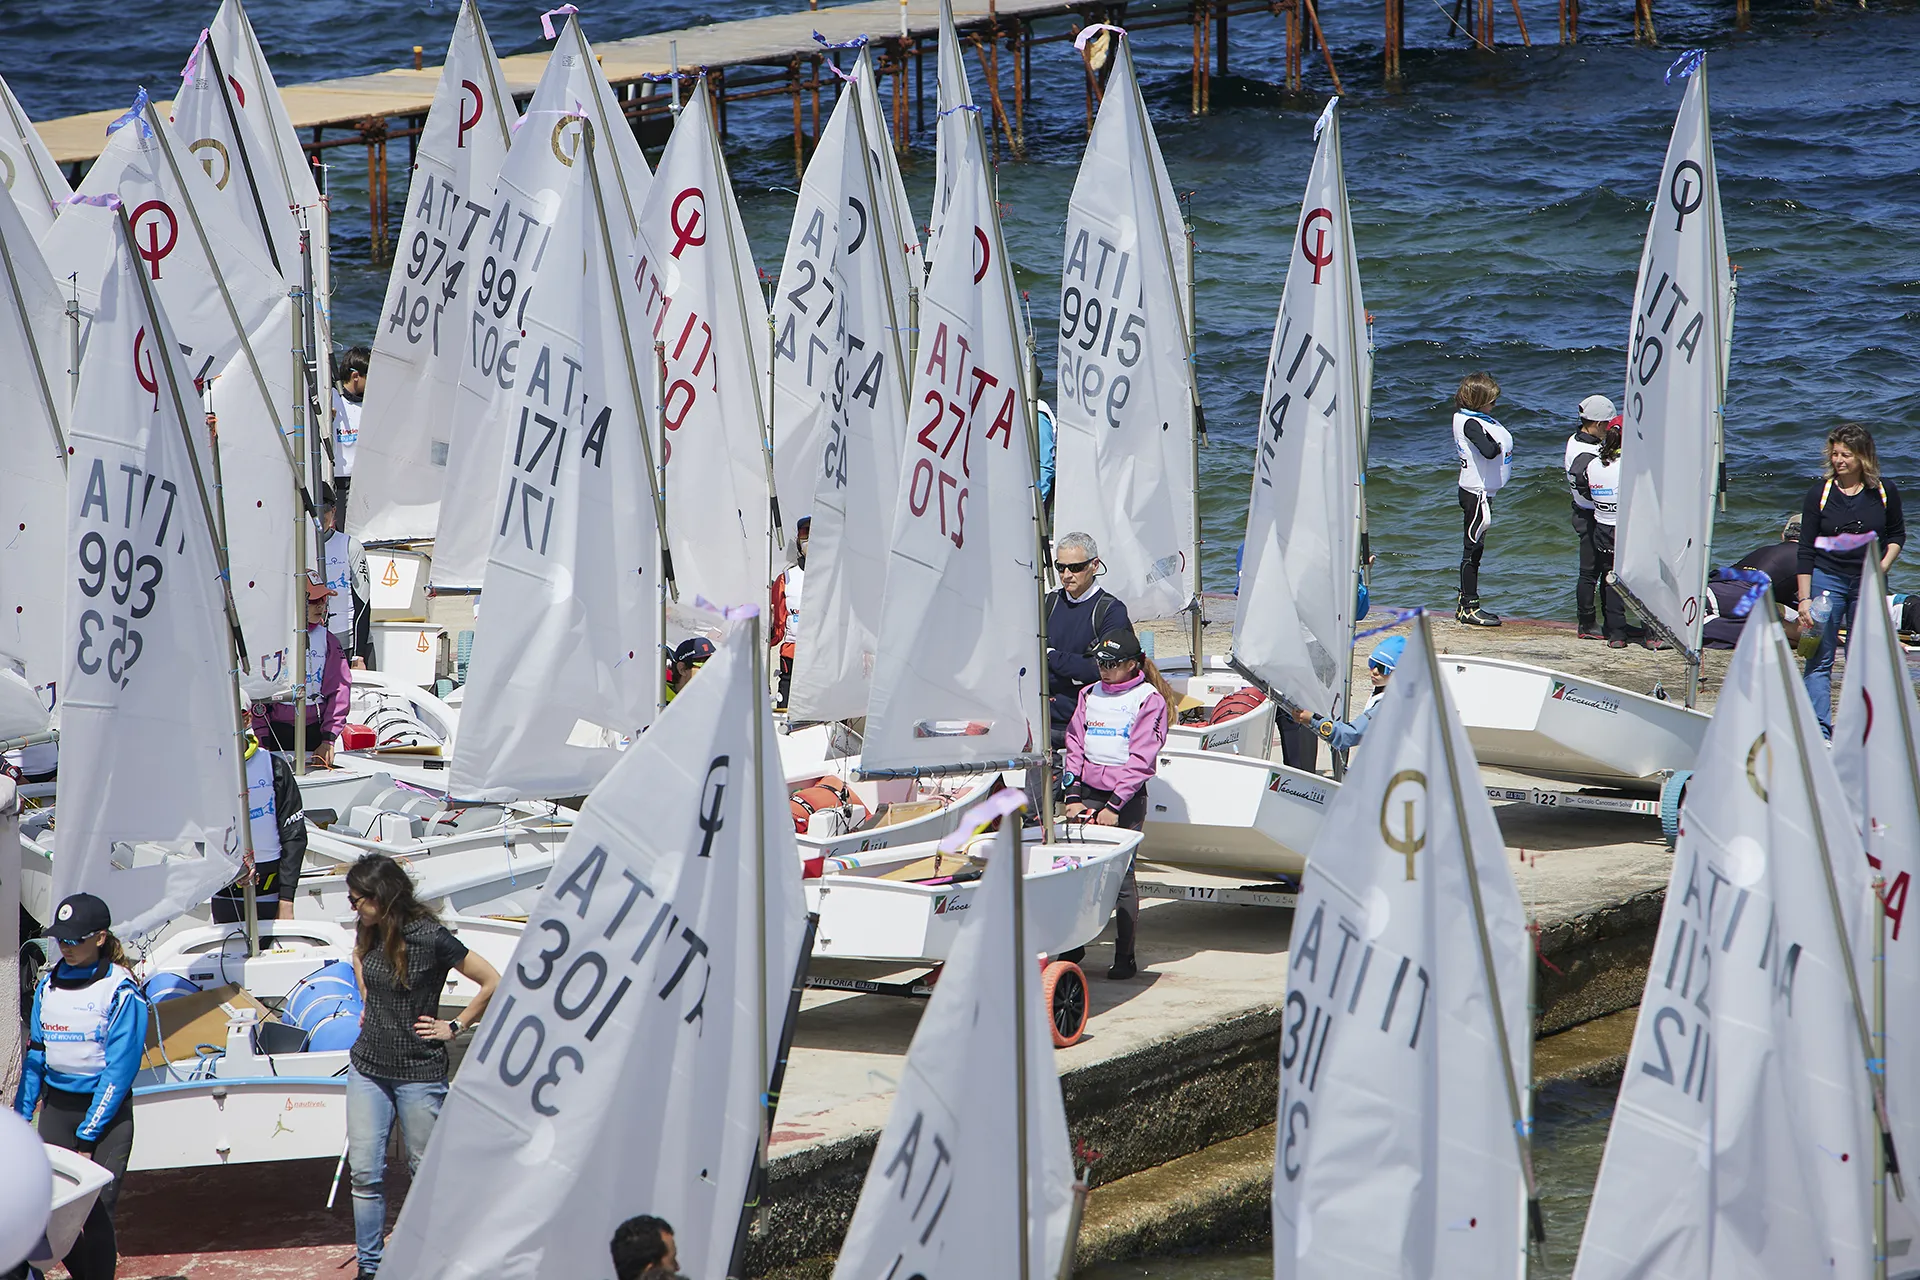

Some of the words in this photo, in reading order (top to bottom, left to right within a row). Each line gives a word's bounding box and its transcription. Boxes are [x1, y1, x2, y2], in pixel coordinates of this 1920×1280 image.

[1061, 286, 1145, 368] 9915
[1647, 271, 1704, 365] ITA
[514, 405, 567, 487] 171
[78, 531, 163, 618] 993
[1534, 793, 1557, 806] 122
[1189, 886, 1215, 899] 117
[517, 918, 633, 1042] 301
[814, 977, 853, 988] VITTORIA
[82, 1082, 116, 1136] ROOSTER
